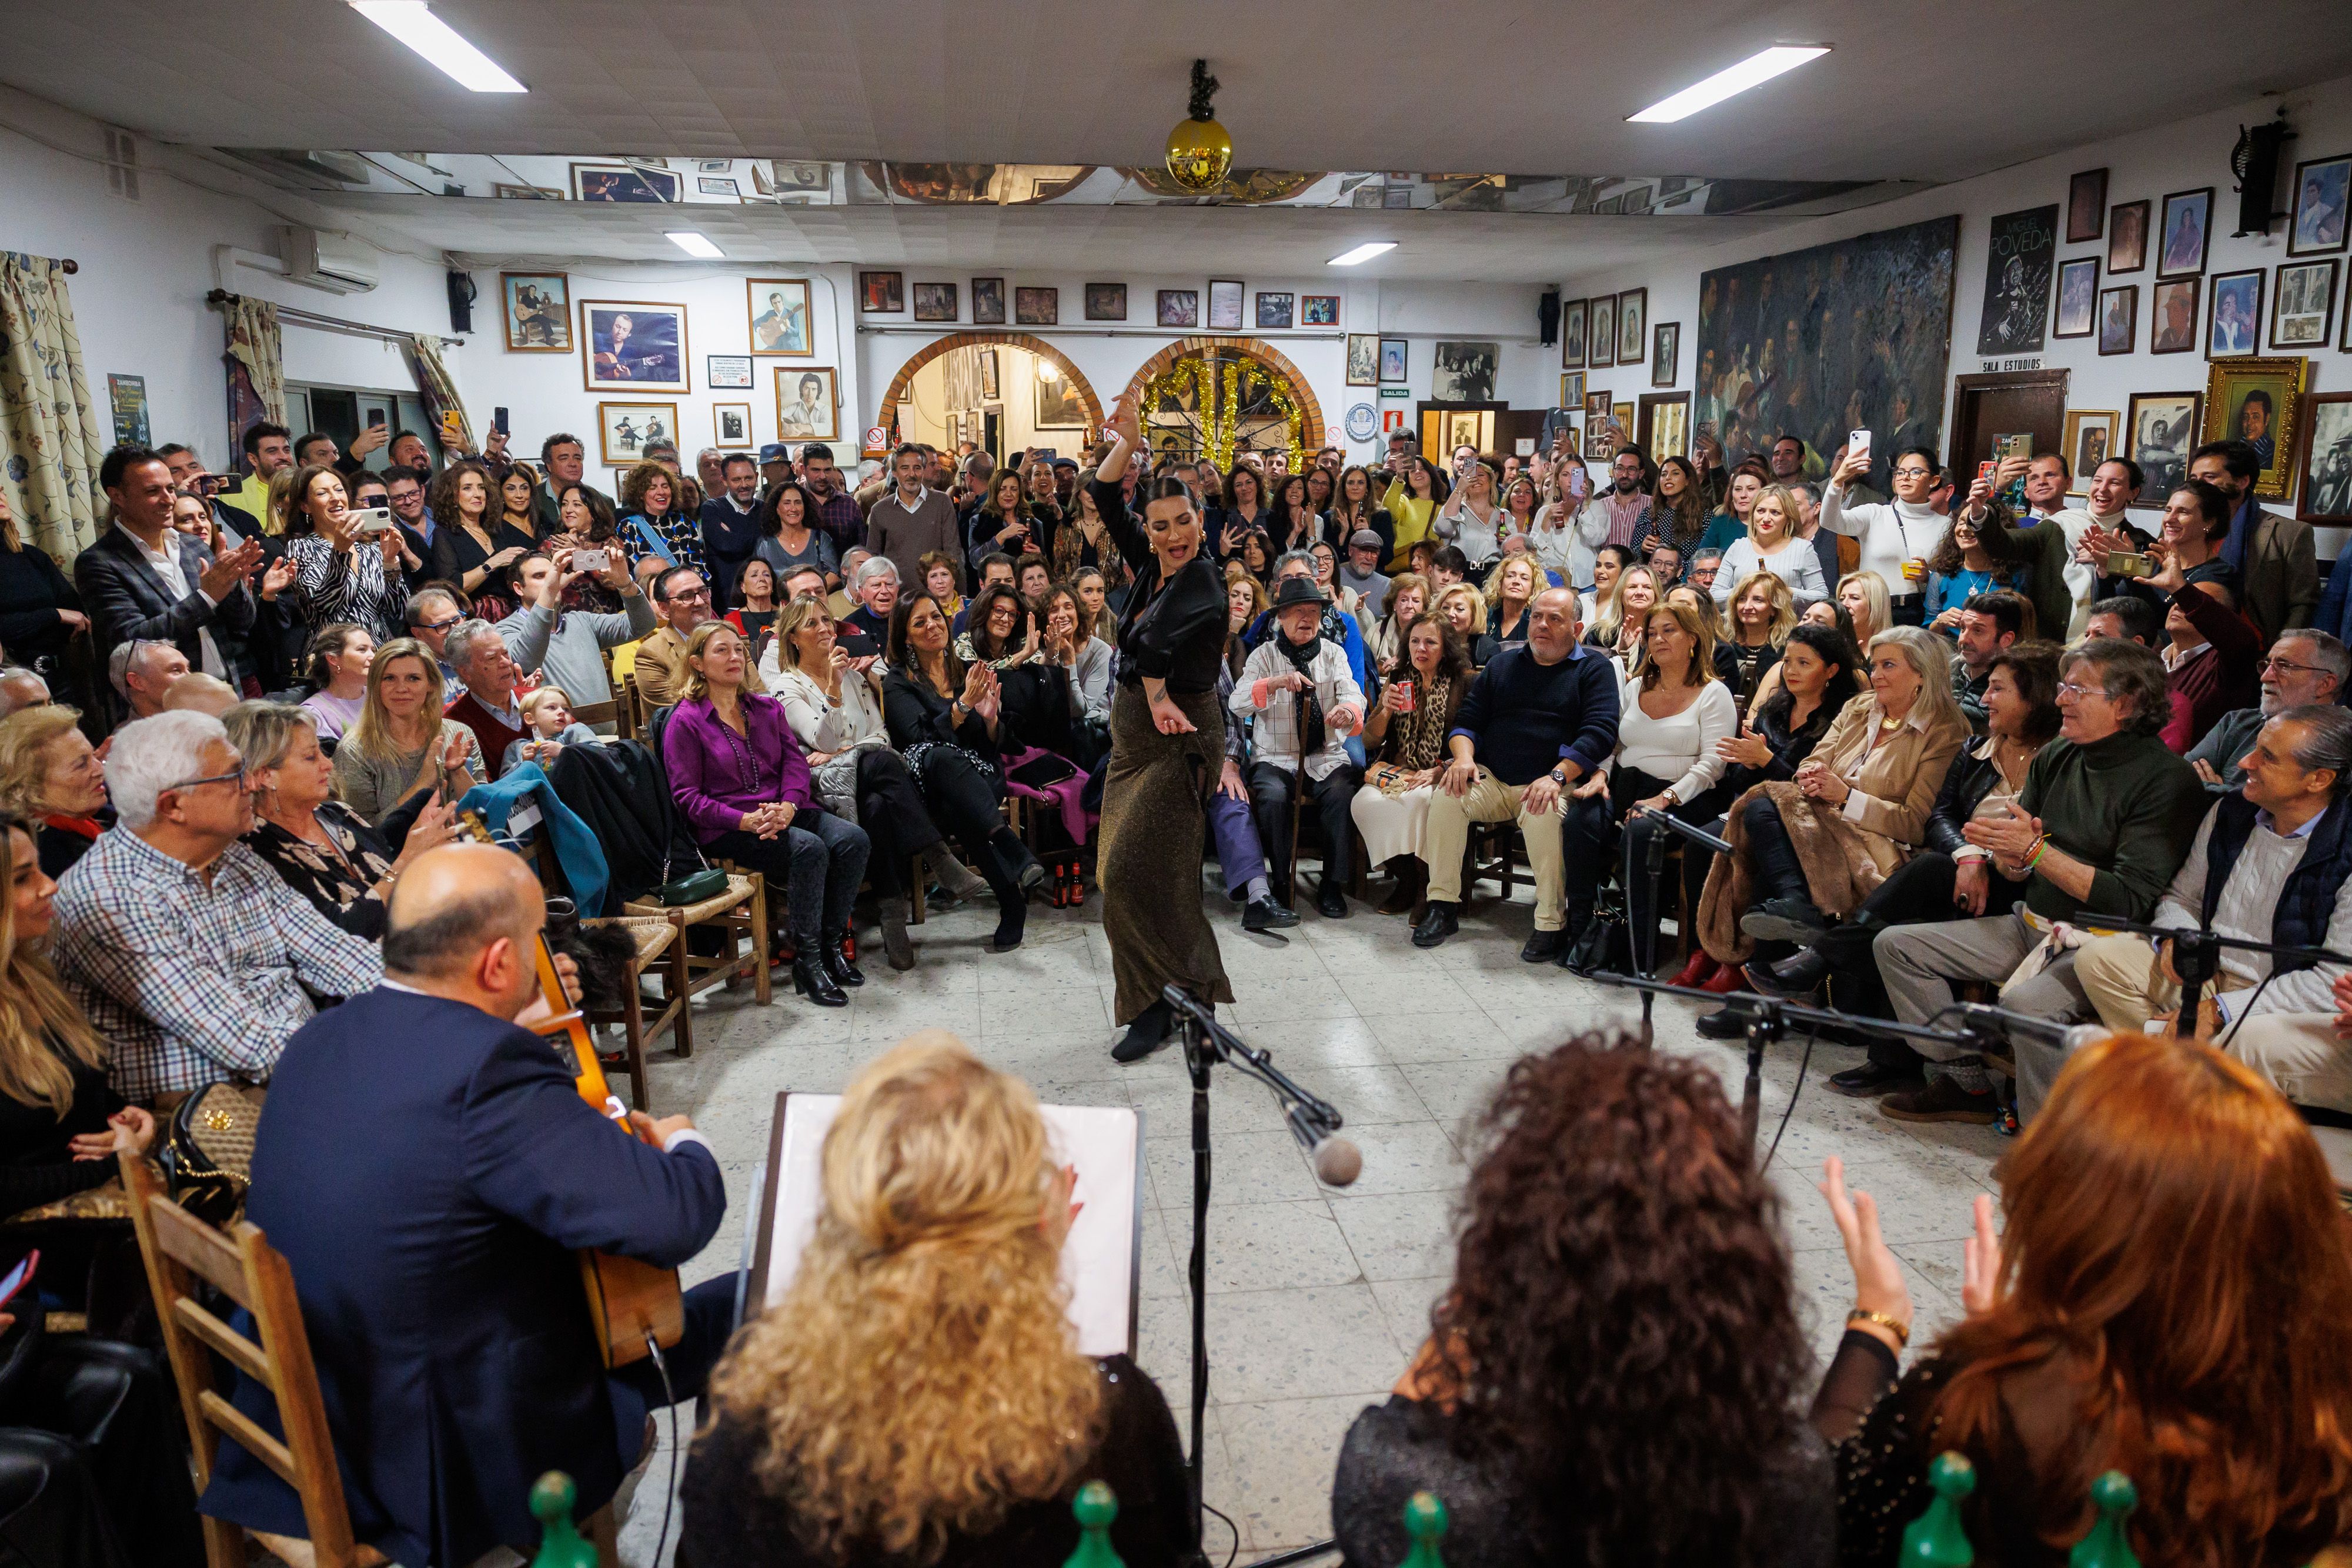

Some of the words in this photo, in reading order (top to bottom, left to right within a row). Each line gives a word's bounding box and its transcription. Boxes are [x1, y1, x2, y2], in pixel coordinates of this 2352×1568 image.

[2006, 218, 2037, 235] MIGUEL
[1990, 228, 2052, 256] POVEDA
[1983, 362, 1999, 372] SALA
[2004, 359, 2040, 371] ESTUDIOS
